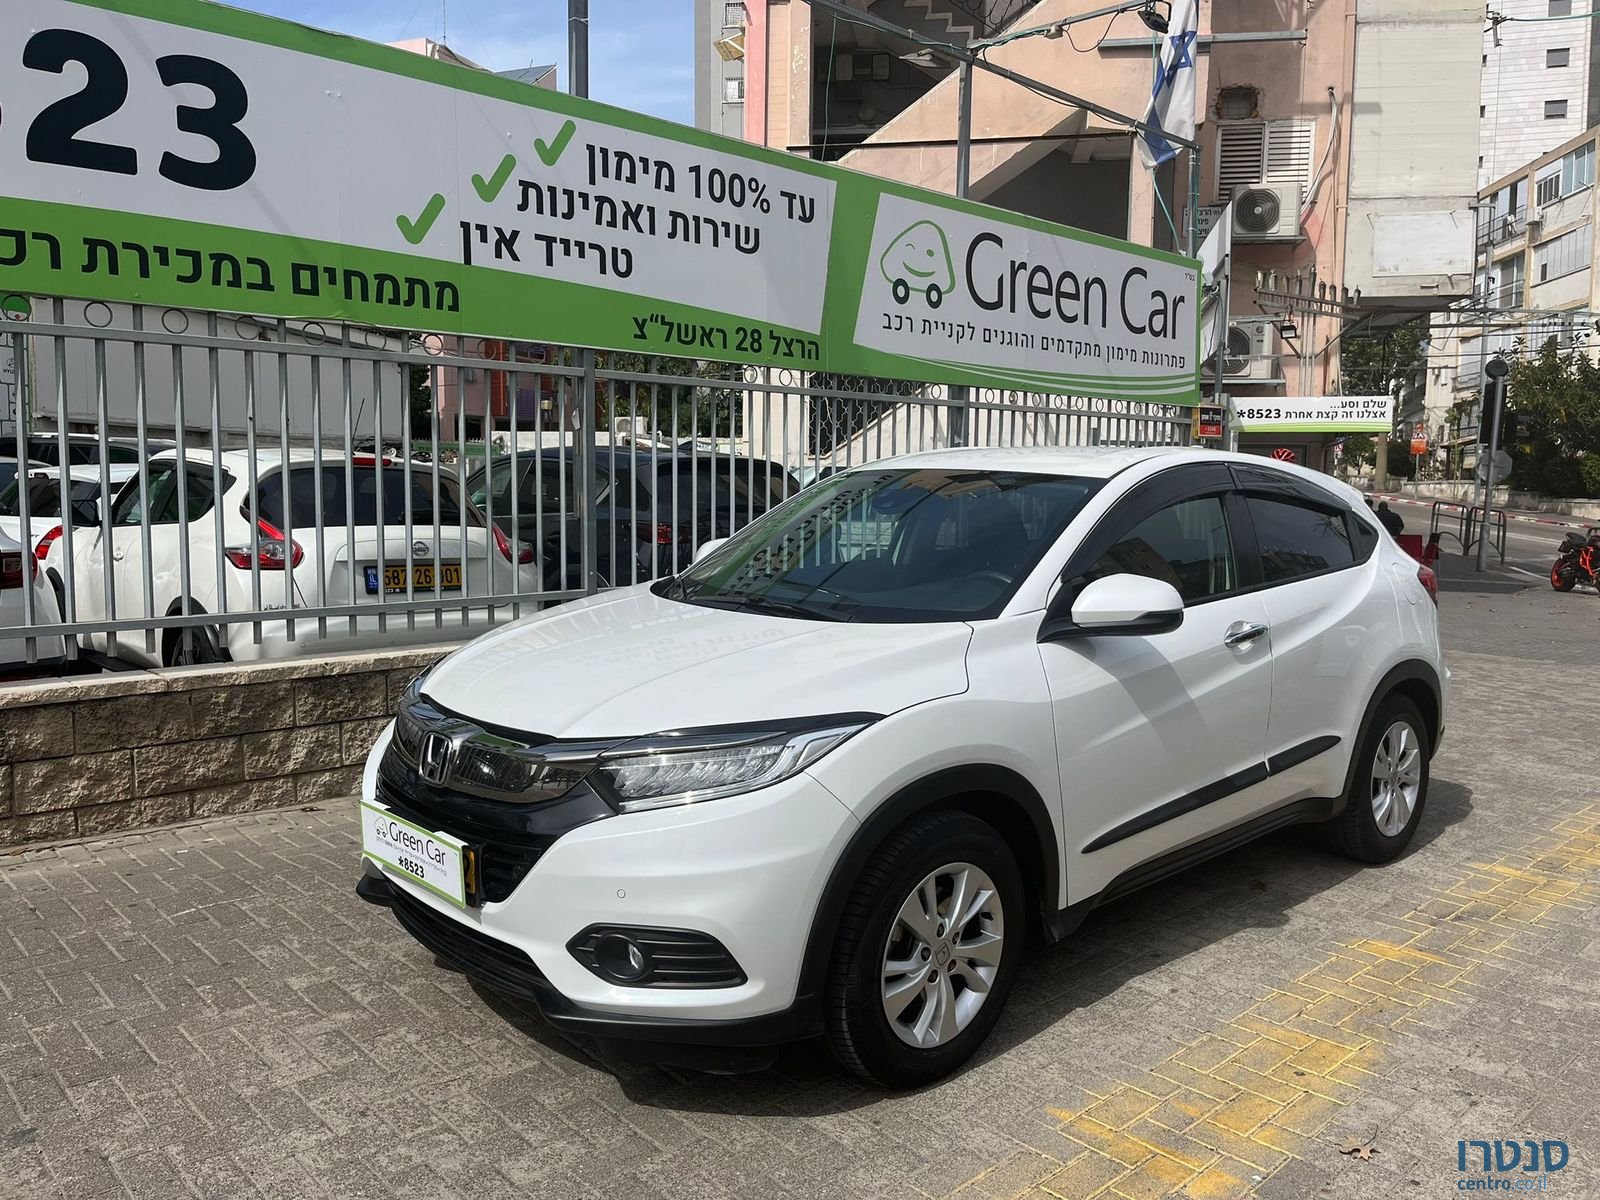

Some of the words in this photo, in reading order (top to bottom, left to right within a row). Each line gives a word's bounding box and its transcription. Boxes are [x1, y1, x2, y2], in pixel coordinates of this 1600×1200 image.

[0, 28, 257, 191] 23
[586, 143, 675, 193] מימון
[689, 164, 771, 214] 100%
[517, 179, 656, 236] ואמינות
[780, 190, 815, 224] עד
[460, 221, 521, 266] אין
[667, 210, 760, 255] שירות
[0, 228, 62, 270] רכ
[81, 237, 275, 292] במכירת
[534, 233, 633, 278] טרייד
[291, 262, 460, 312] מתמחים
[965, 232, 1107, 329] Green
[1120, 267, 1185, 340] Car
[882, 313, 913, 333] רכב
[921, 319, 975, 344] לקניית
[983, 327, 1034, 349] והוגנים
[735, 327, 763, 354] 28
[769, 330, 820, 361] הרצל
[1041, 336, 1101, 359] מתקדמים
[1106, 345, 1137, 363] מימון
[1142, 350, 1185, 369] פתרונות
[1284, 411, 1313, 419] אחרת
[1316, 411, 1338, 420] קצת
[1341, 411, 1354, 419] זה
[1356, 409, 1386, 419] אצלנו
[1362, 399, 1387, 409] שלם
[389, 821, 424, 855] Green
[426, 839, 446, 866] Car
